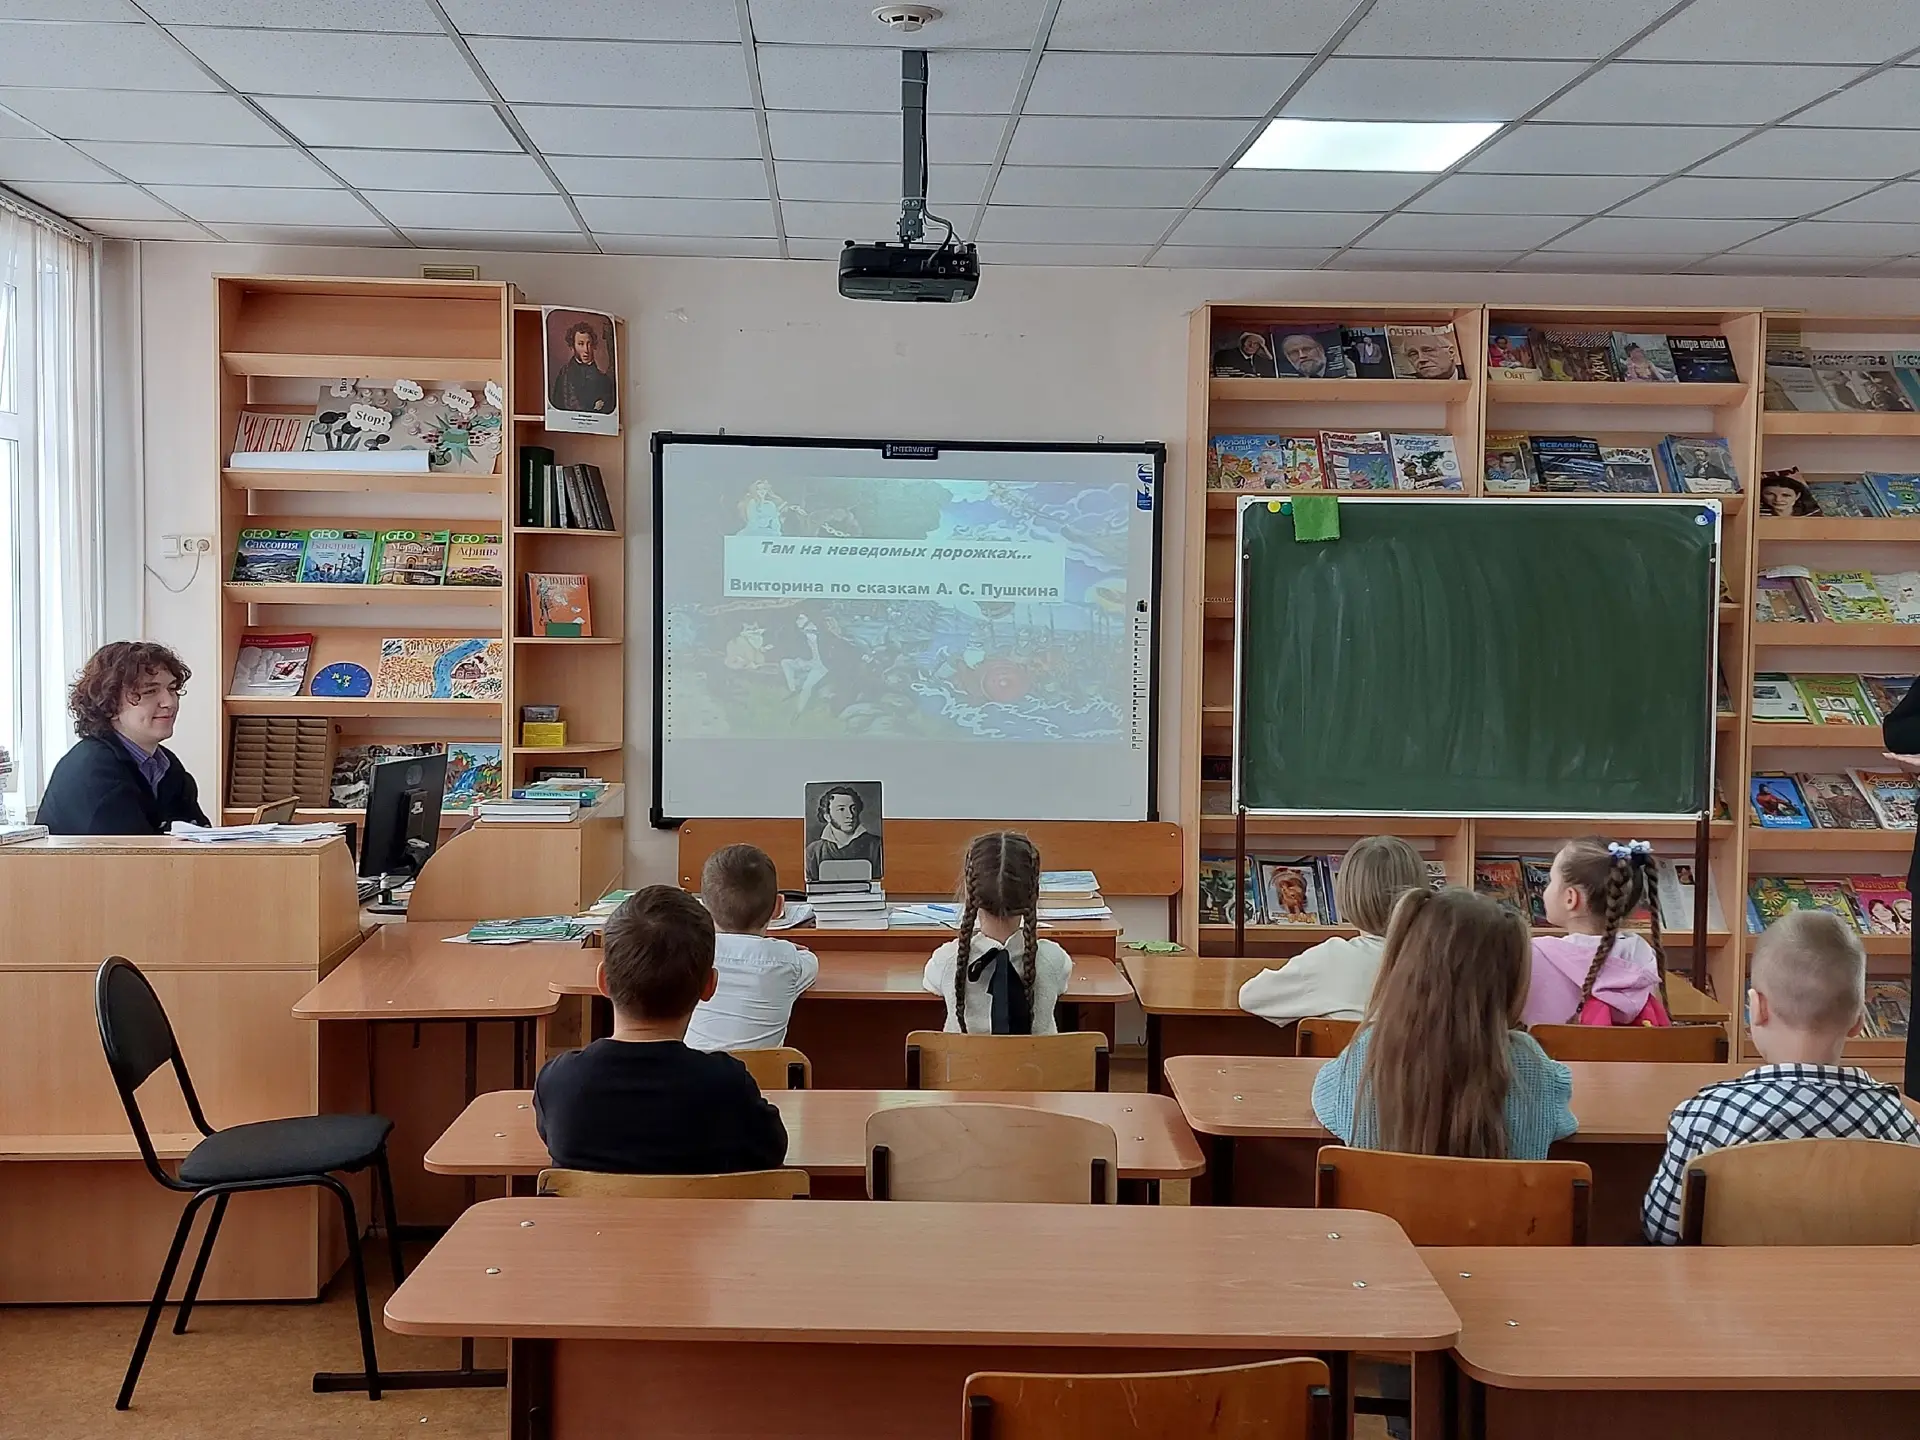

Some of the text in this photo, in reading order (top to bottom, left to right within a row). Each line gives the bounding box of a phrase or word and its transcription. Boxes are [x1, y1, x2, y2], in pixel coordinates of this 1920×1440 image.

[355, 411, 386, 426] Stop!
[242, 529, 272, 539] GEO
[309, 529, 340, 540] GEO
[386, 531, 416, 541] GEO
[451, 534, 480, 544] GEO
[245, 540, 299, 550] Саксония
[761, 541, 1032, 560] Там на неведомых дорожках...
[456, 546, 499, 557] Афины
[730, 578, 1059, 598] Викторина по сказкам А. С. Пушкина
